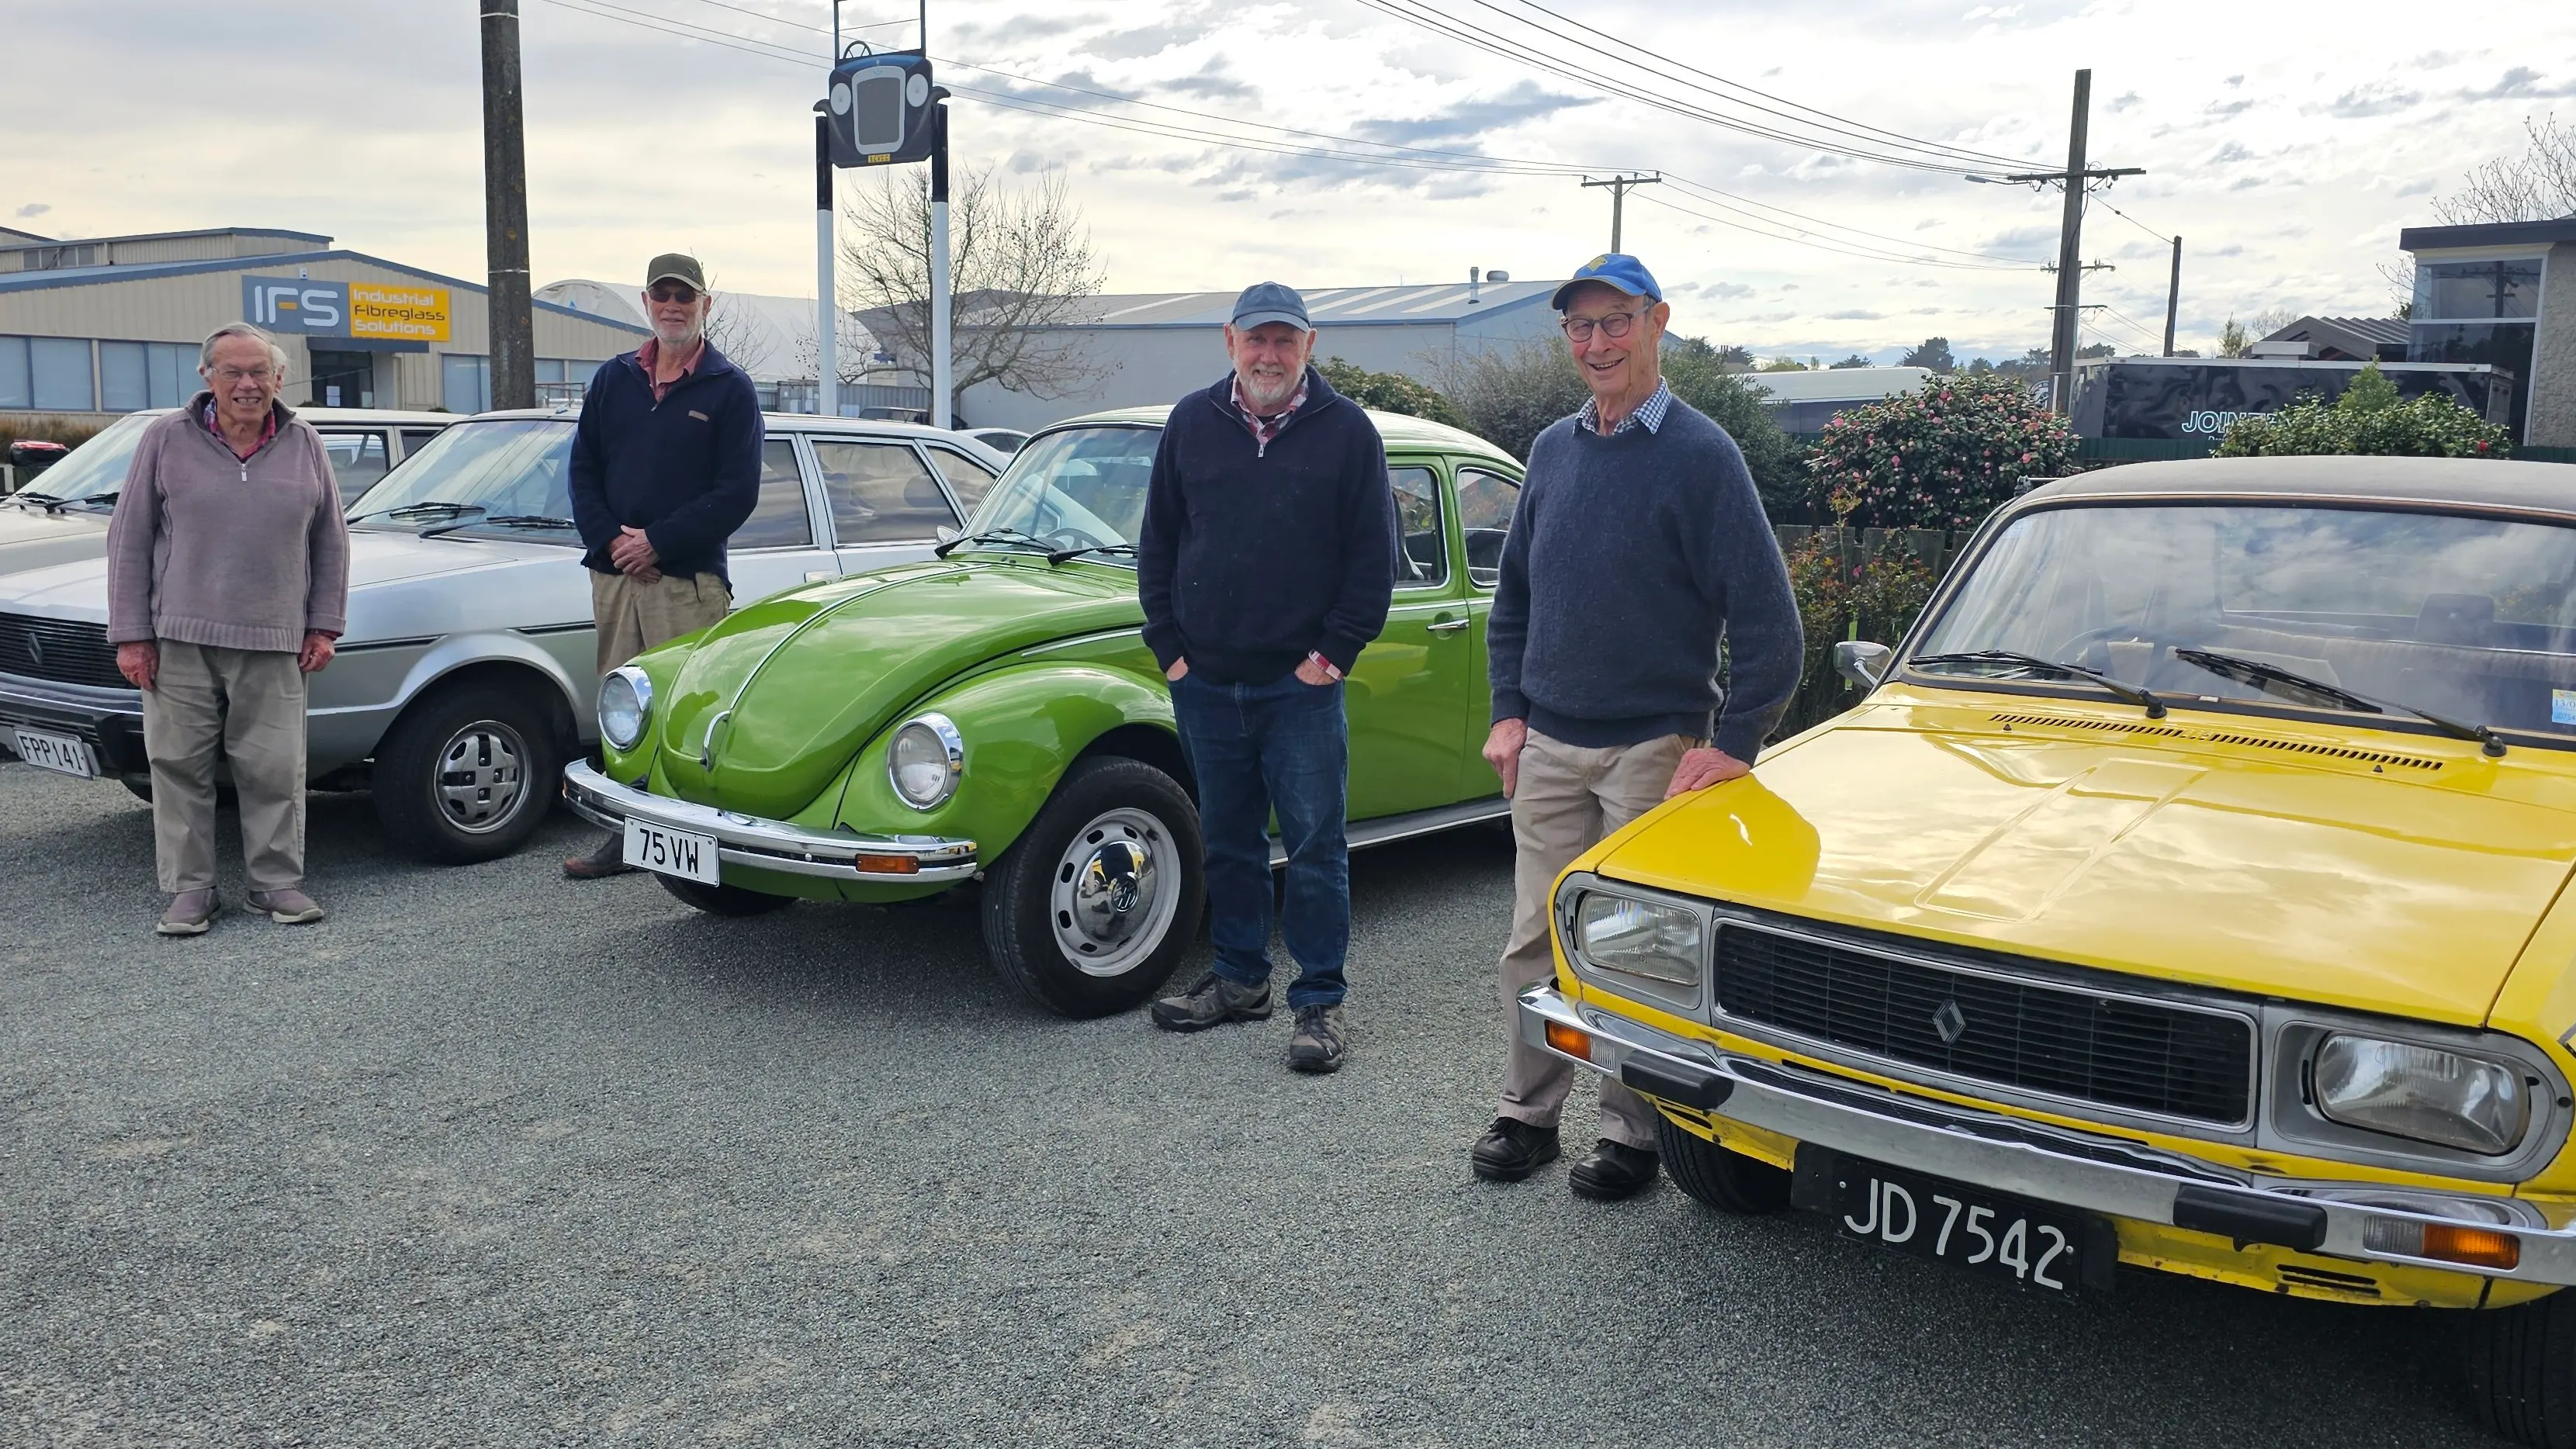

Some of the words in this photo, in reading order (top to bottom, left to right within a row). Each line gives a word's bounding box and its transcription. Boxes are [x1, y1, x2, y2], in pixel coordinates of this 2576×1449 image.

[254, 285, 340, 327] IFS
[353, 289, 435, 306] Industrial
[355, 304, 445, 320] Fibreglass
[355, 319, 436, 335] Solutions
[19, 735, 82, 771] FPP141
[1844, 1170, 1917, 1243] JD
[1933, 1194, 2065, 1289] 7542
